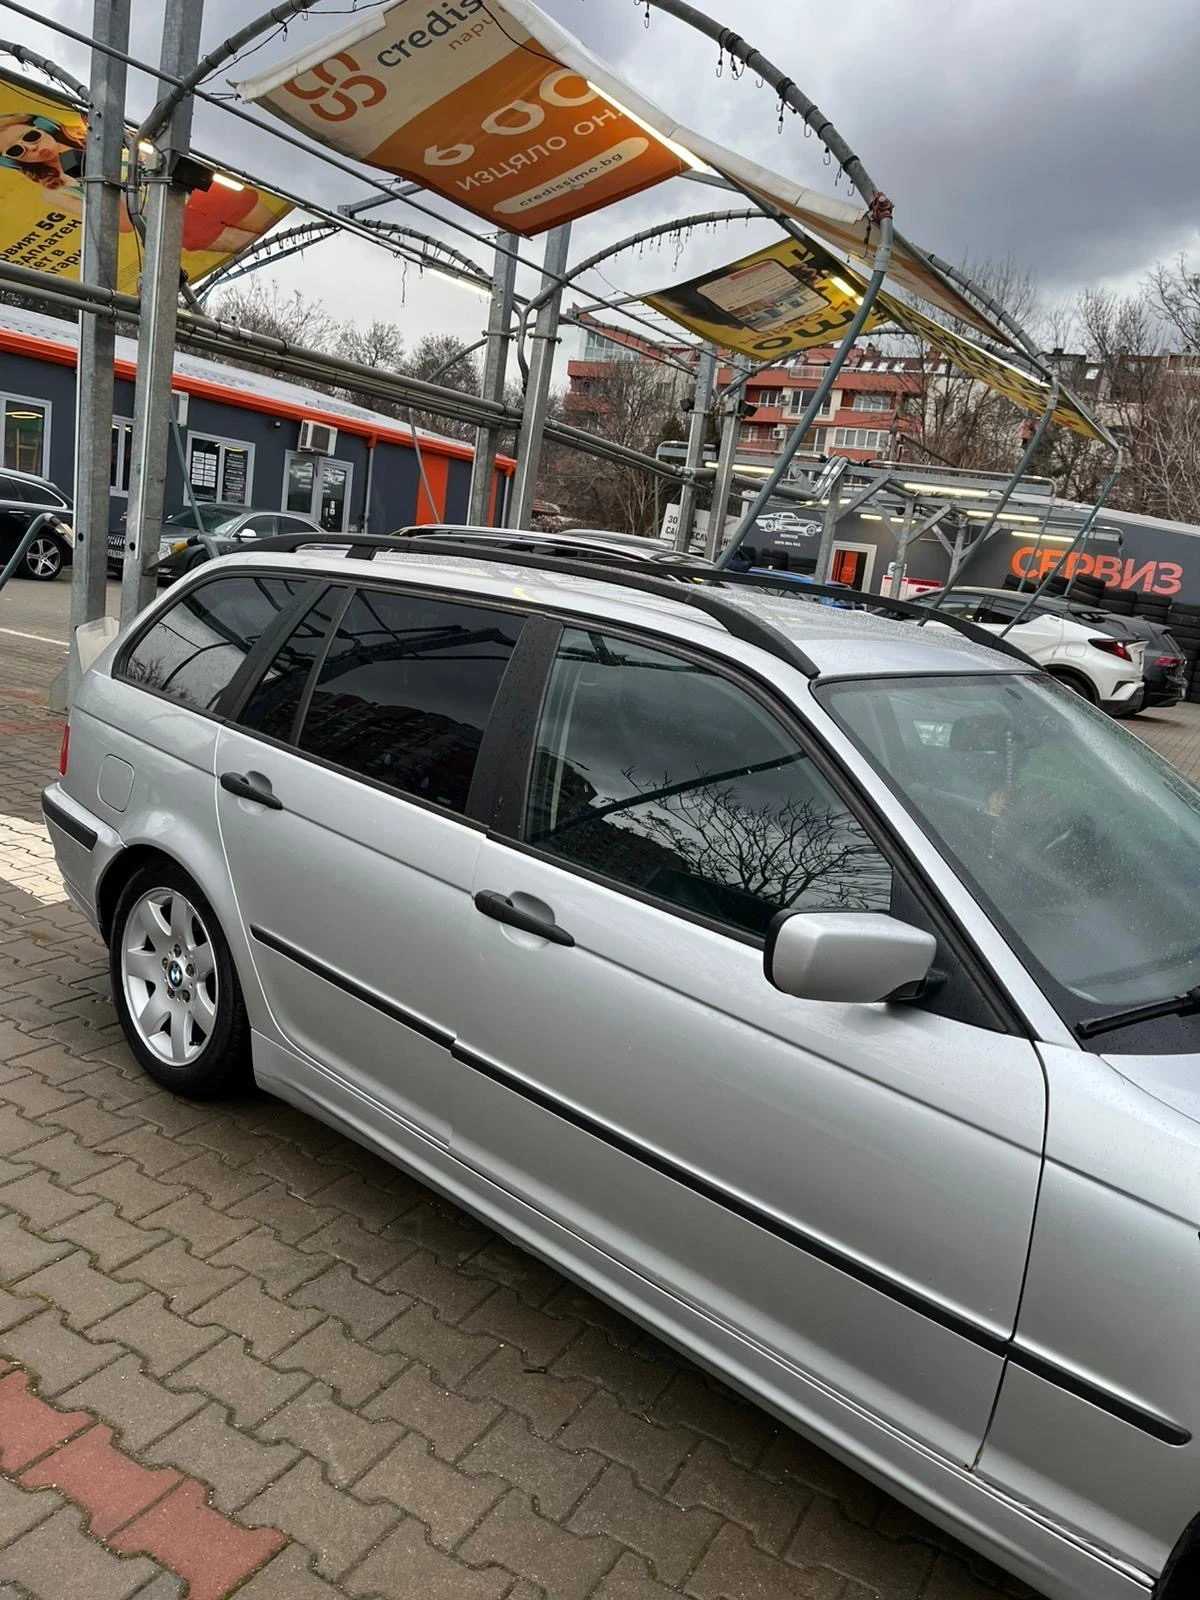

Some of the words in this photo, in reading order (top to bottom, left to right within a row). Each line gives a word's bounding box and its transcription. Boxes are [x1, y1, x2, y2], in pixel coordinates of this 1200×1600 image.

[519, 152, 623, 207] credissimo.bg
[0, 231, 42, 263] рвият
[36, 211, 67, 231] 5G
[11, 219, 83, 265] едплатен
[1010, 546, 1184, 596] СЕРВИЗ
